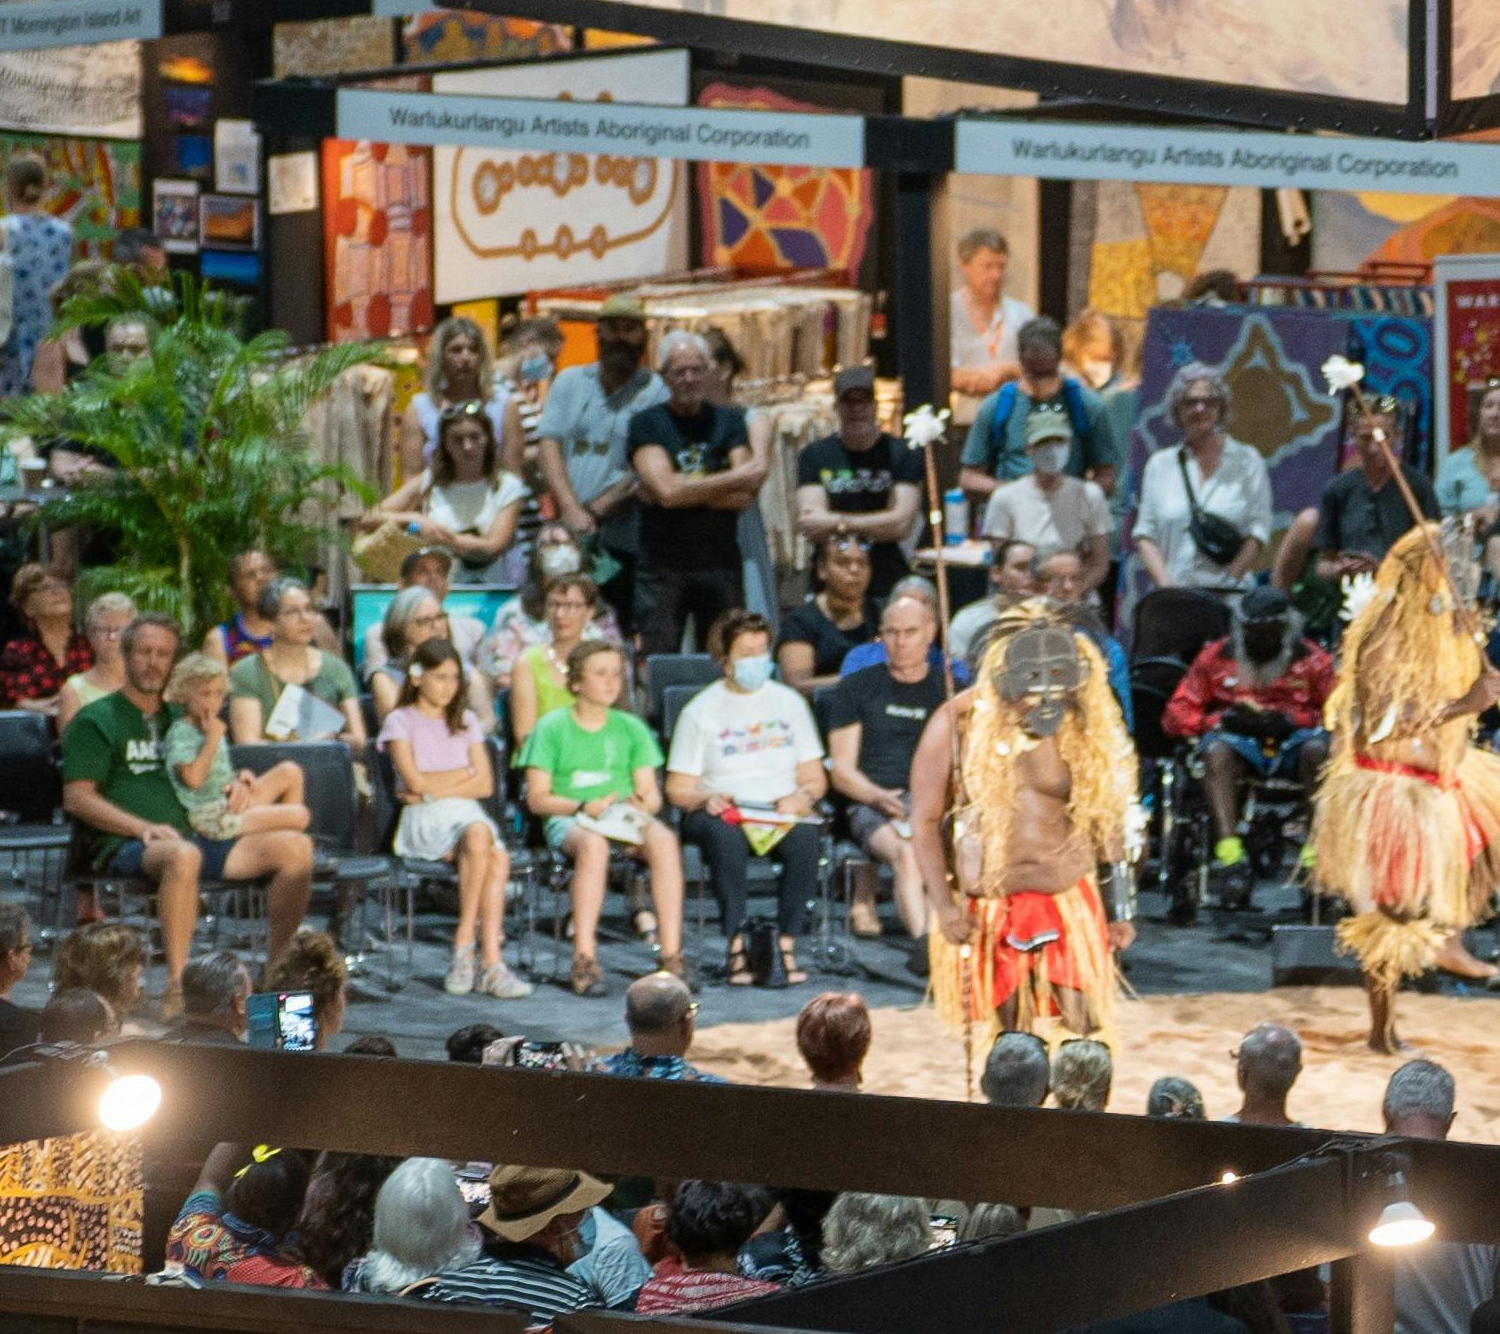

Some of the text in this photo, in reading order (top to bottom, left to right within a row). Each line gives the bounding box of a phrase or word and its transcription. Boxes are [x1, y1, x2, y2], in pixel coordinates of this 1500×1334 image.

[389, 107, 810, 150] Warlukurlangu Artists Aboriginal Corporation
[1011, 138, 1459, 180] Warlukurlangu Artists Aboriginal Corporation
